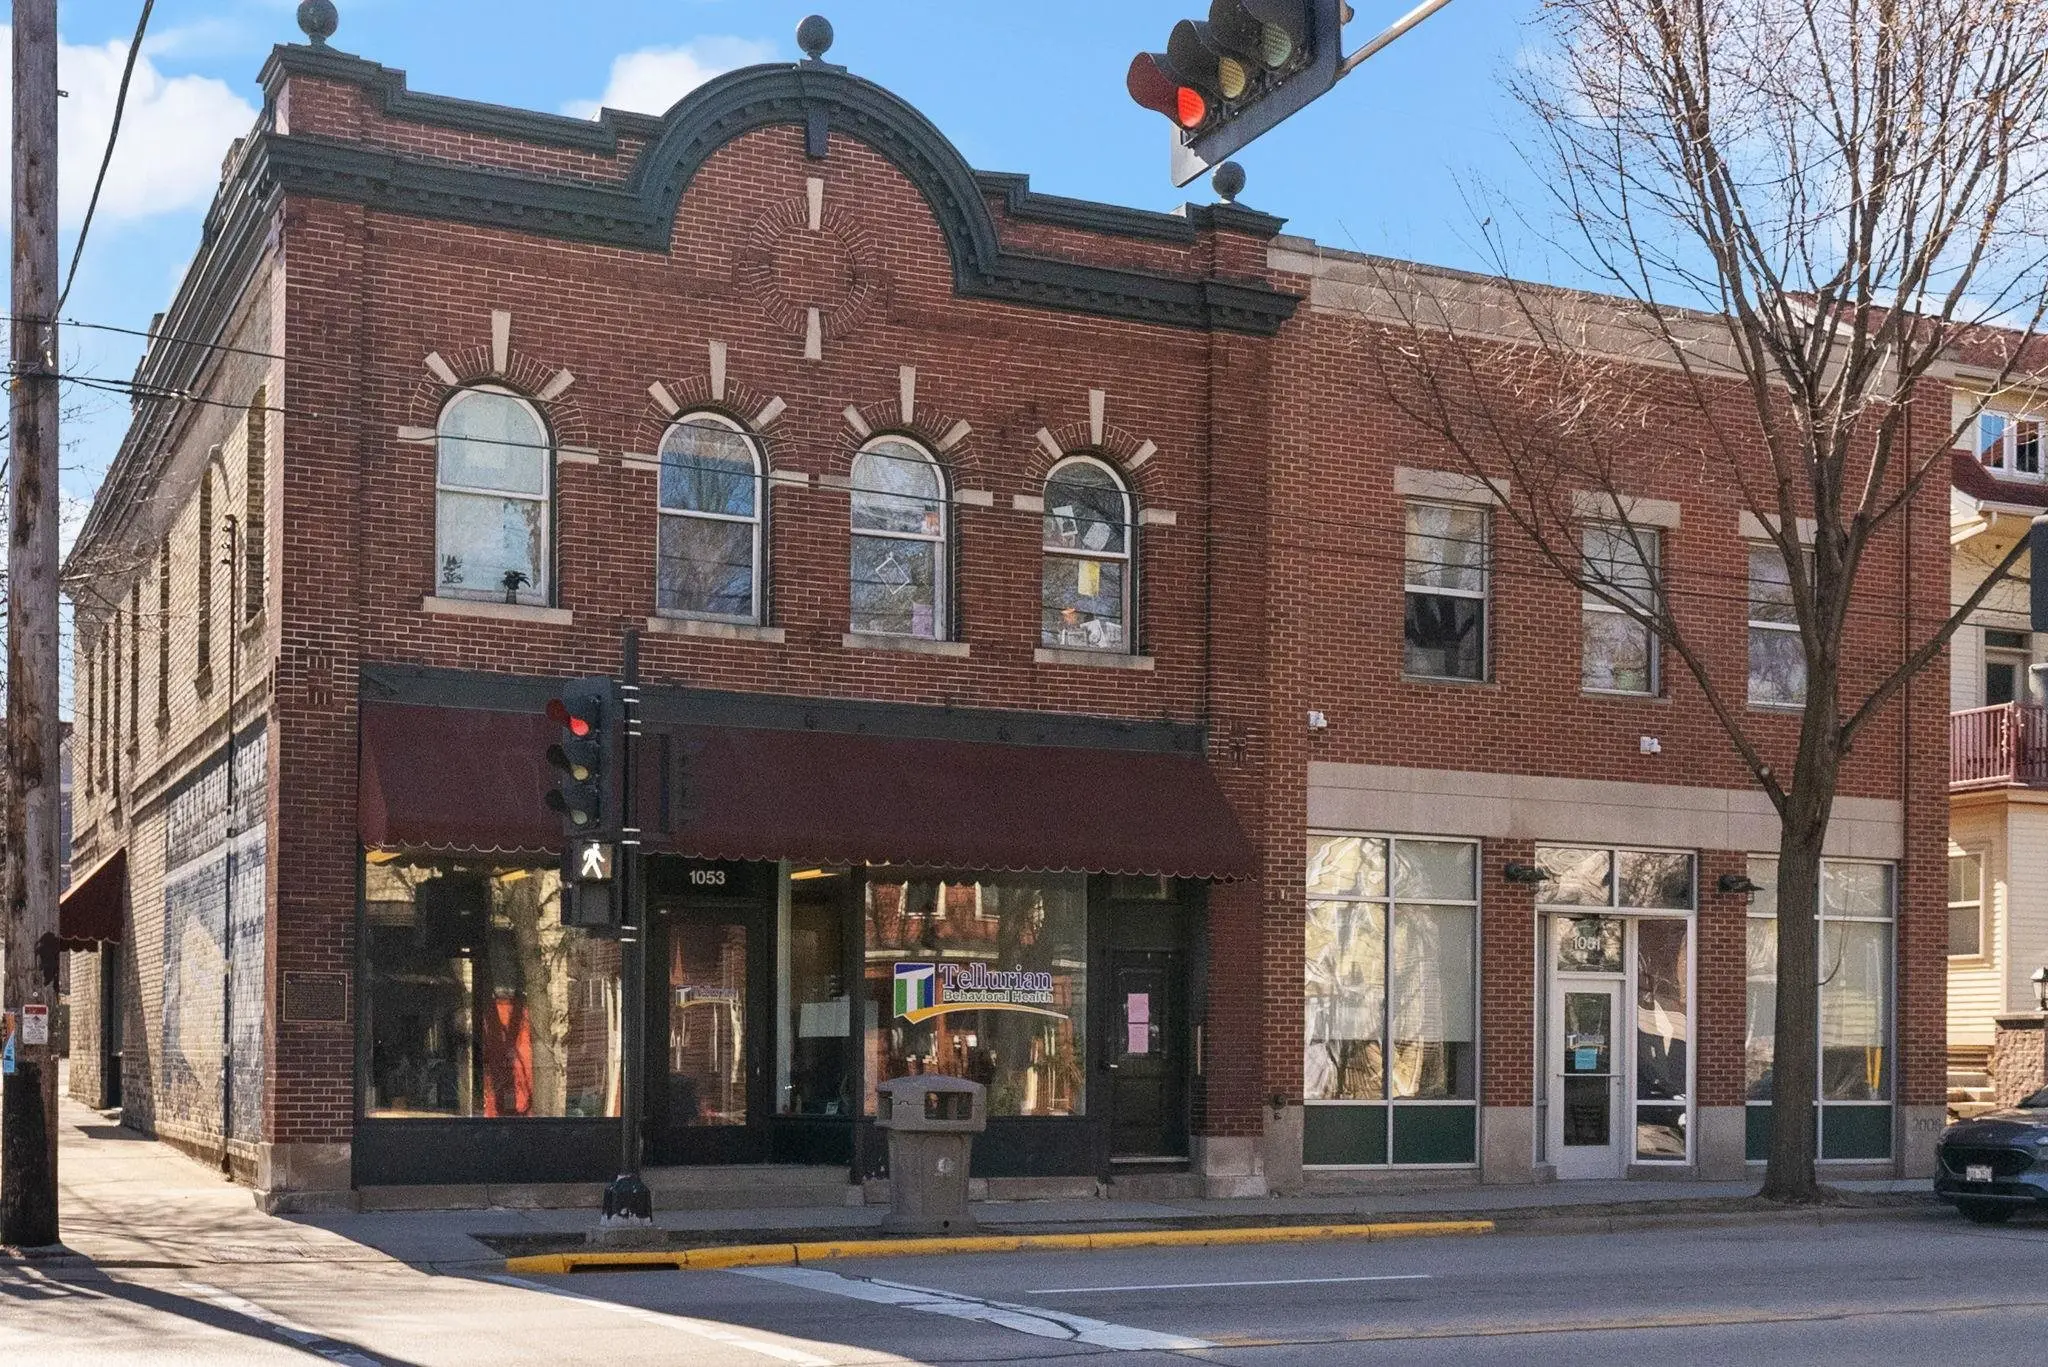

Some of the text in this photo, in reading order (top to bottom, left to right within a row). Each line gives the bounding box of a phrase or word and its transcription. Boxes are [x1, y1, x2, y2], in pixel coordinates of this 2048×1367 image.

[689, 870, 726, 885] 1053
[1573, 936, 1600, 951] 1051
[939, 963, 1053, 991] Tellurian
[943, 990, 1054, 1003] Behavioral Health
